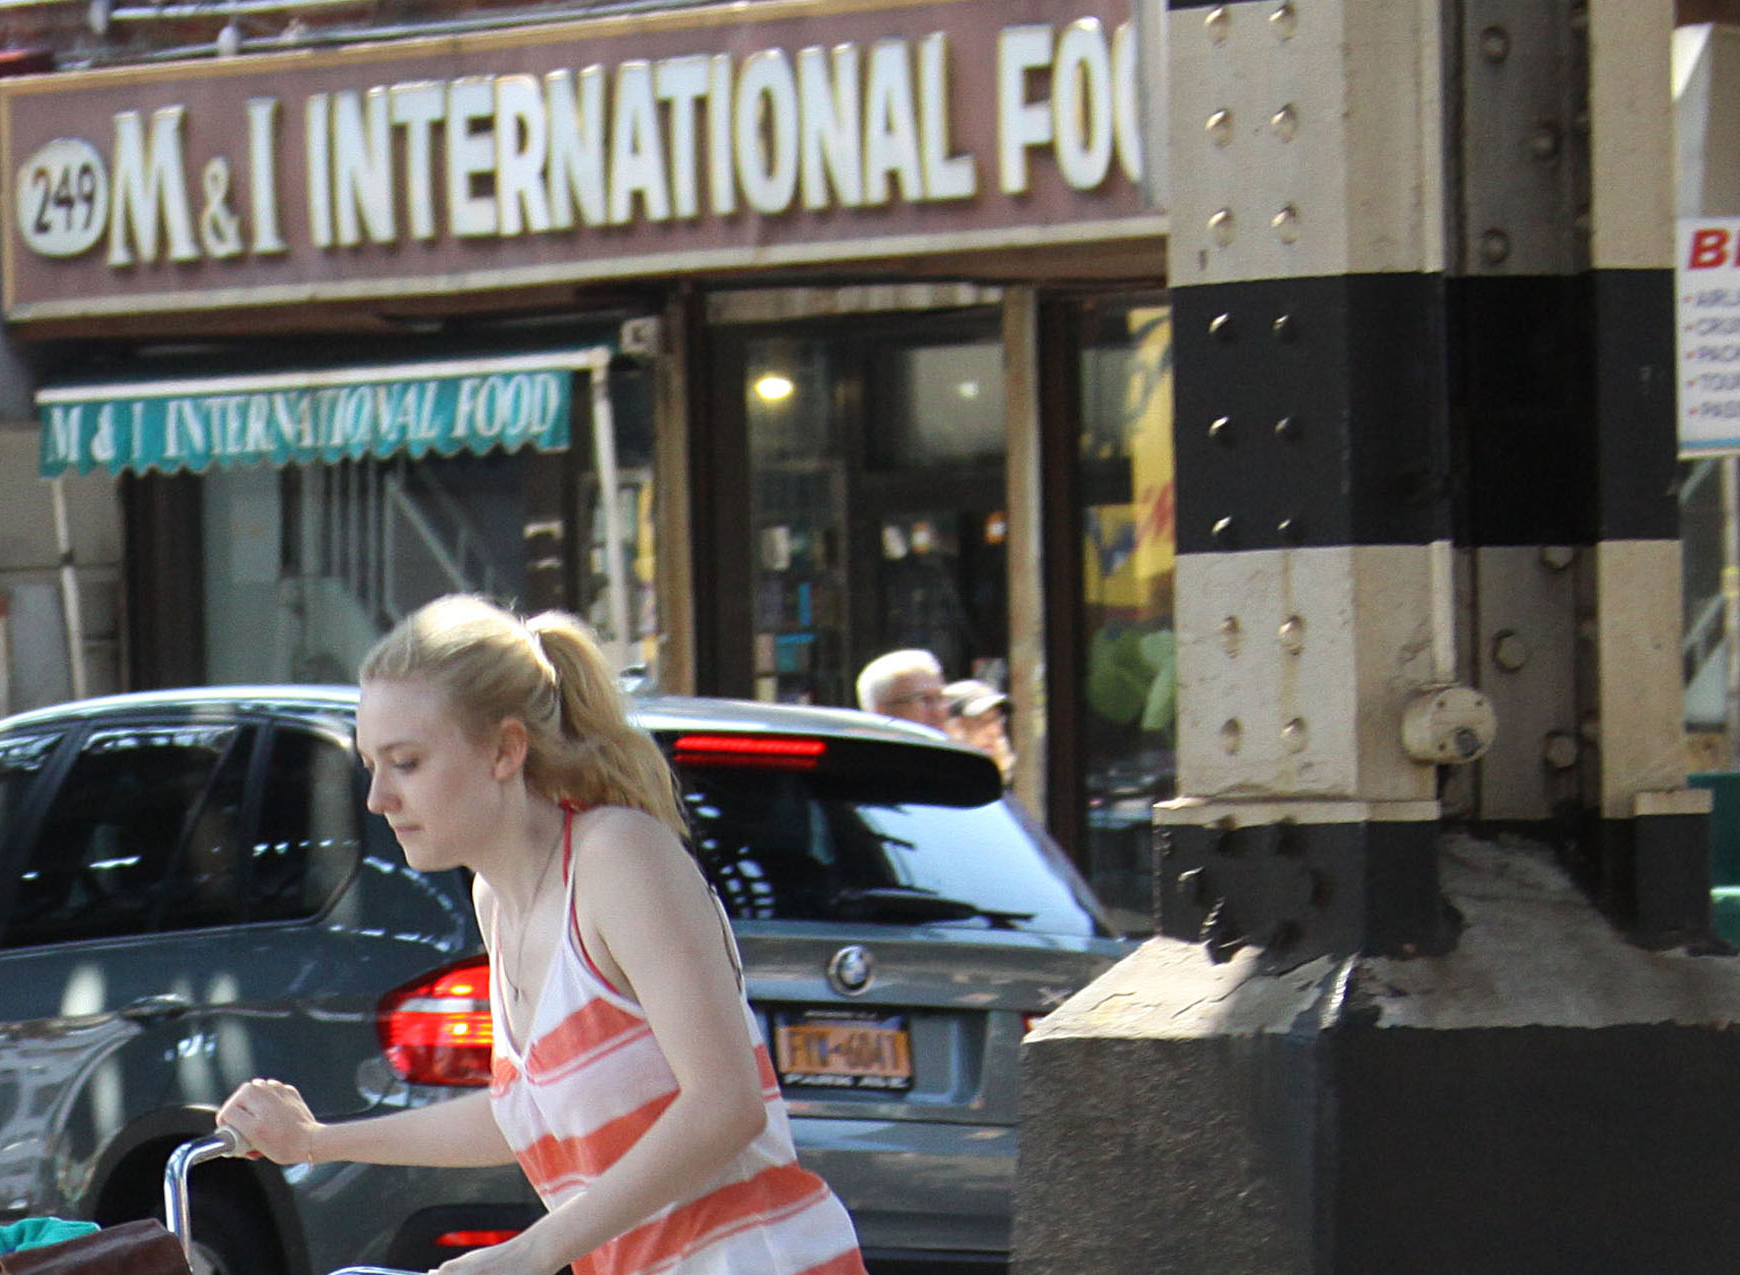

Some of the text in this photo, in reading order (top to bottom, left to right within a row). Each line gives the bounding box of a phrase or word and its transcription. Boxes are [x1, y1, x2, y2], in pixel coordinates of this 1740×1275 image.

[31, 166, 97, 234] 249
[107, 105, 200, 267] M
[202, 157, 242, 259] &
[245, 96, 287, 254] I
[305, 30, 976, 249] INTERNATIONAL
[48, 405, 82, 463] M
[90, 403, 116, 461] &
[163, 380, 440, 458] INTERNATIONAL
[450, 373, 561, 439] FOOD
